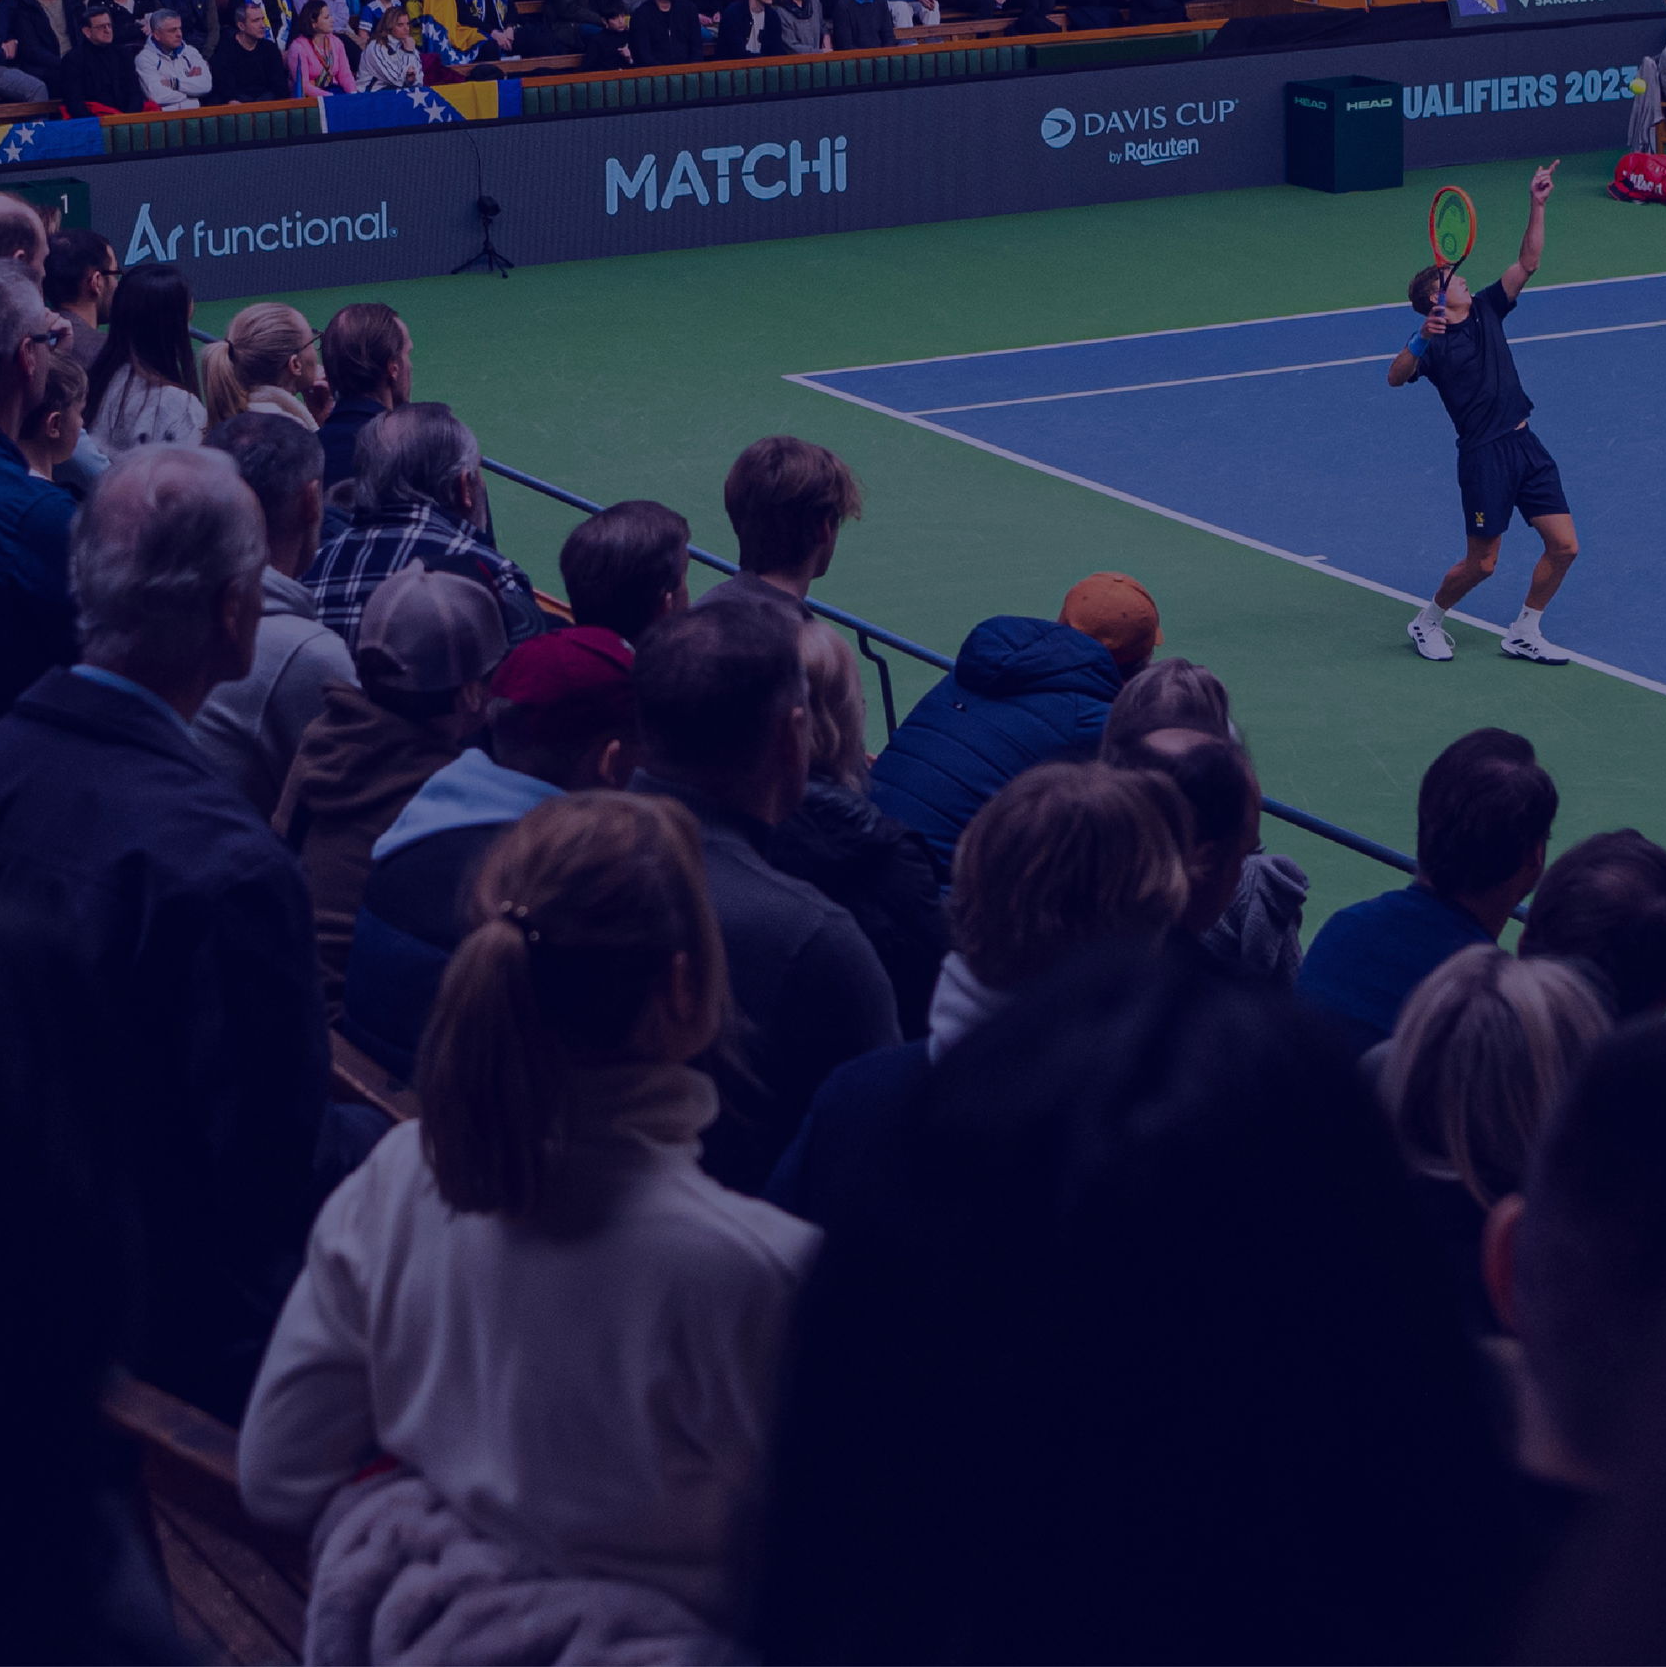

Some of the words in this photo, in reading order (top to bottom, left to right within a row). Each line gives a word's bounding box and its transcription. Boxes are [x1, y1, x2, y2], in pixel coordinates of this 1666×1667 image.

[1293, 95, 1328, 111] HEAD
[1345, 97, 1394, 112] HEAD
[1402, 74, 1558, 120] UALIFIERS
[1565, 65, 1640, 105] 2023
[1084, 105, 1167, 136] DAVIS
[1175, 99, 1235, 126] CUP
[1108, 150, 1122, 165] by
[1124, 137, 1200, 162] Rakuten
[60, 193, 69, 215] 1
[193, 200, 388, 259] functional
